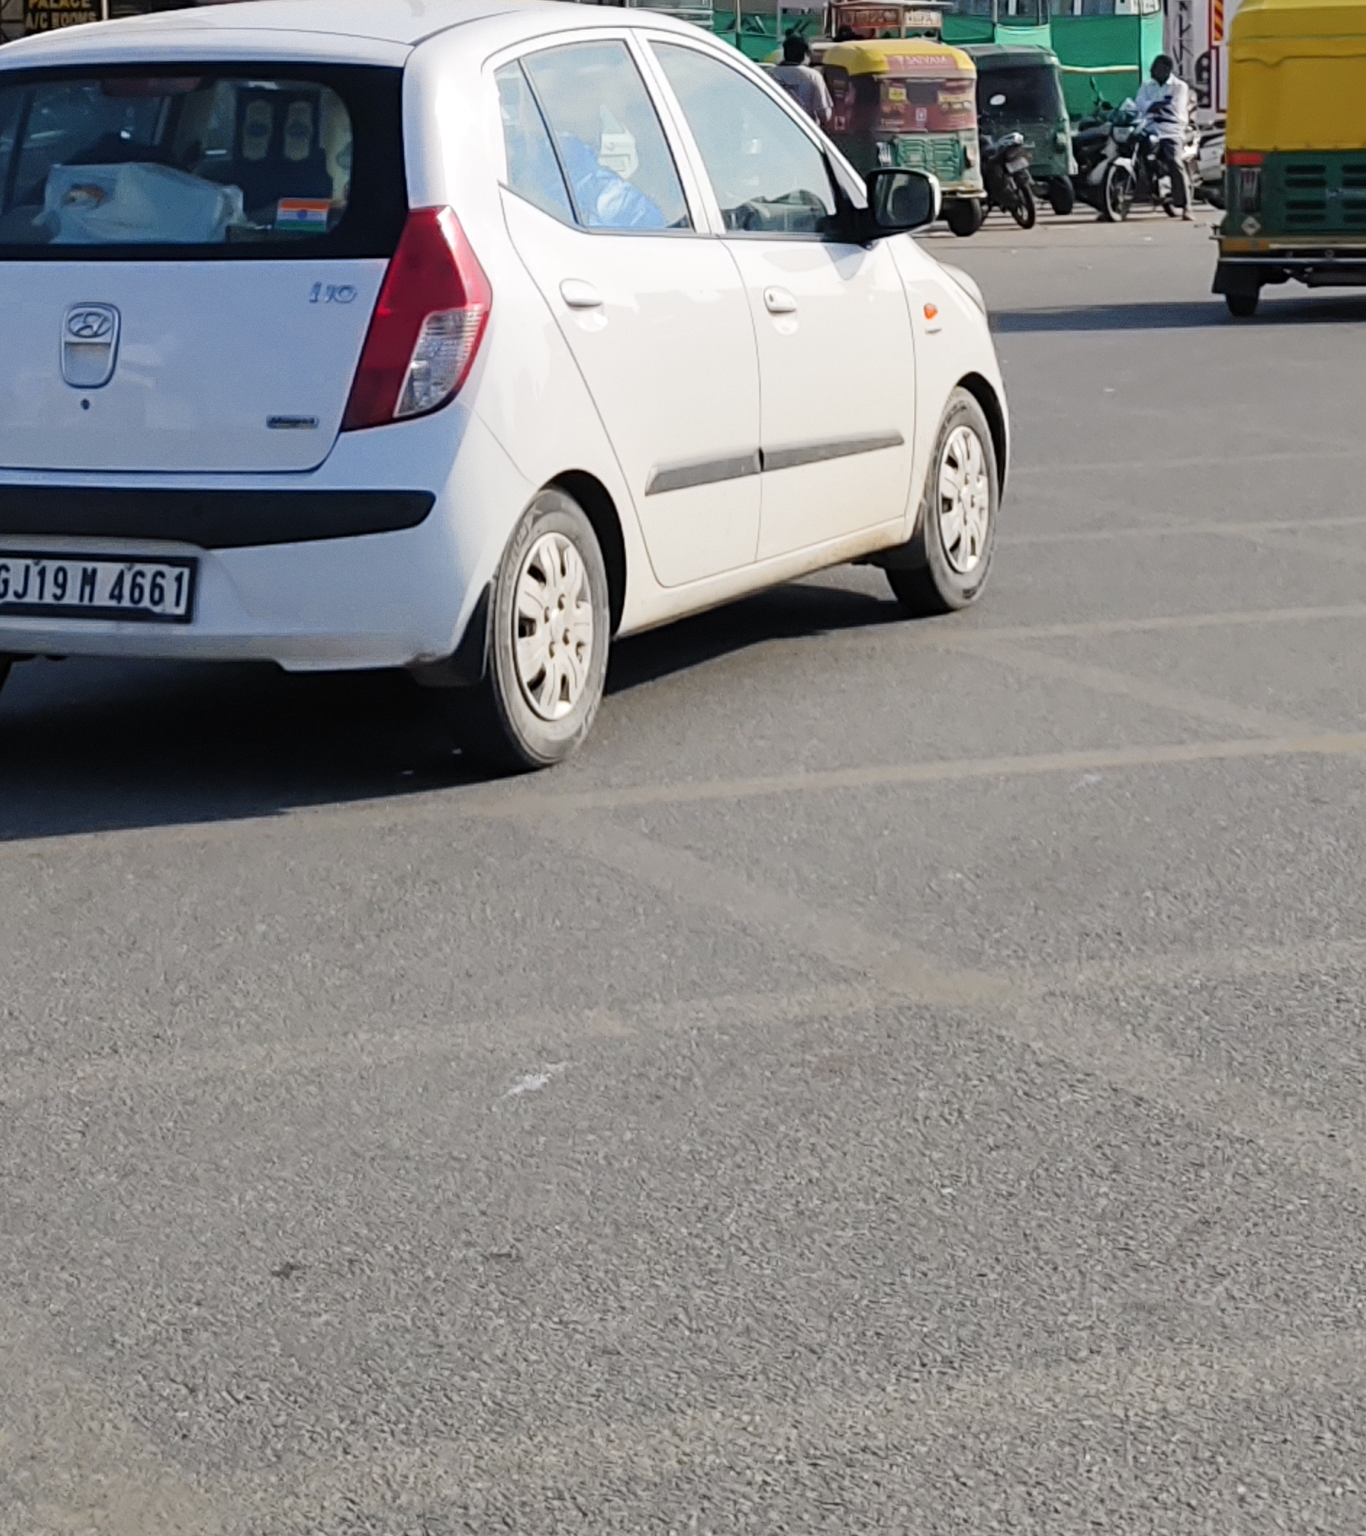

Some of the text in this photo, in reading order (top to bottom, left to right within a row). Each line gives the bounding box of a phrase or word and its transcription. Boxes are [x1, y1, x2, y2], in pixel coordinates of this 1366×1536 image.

[25, 11, 97, 30] A/C ROOMS
[79, 567, 98, 604] M
[109, 569, 185, 608] 4661
